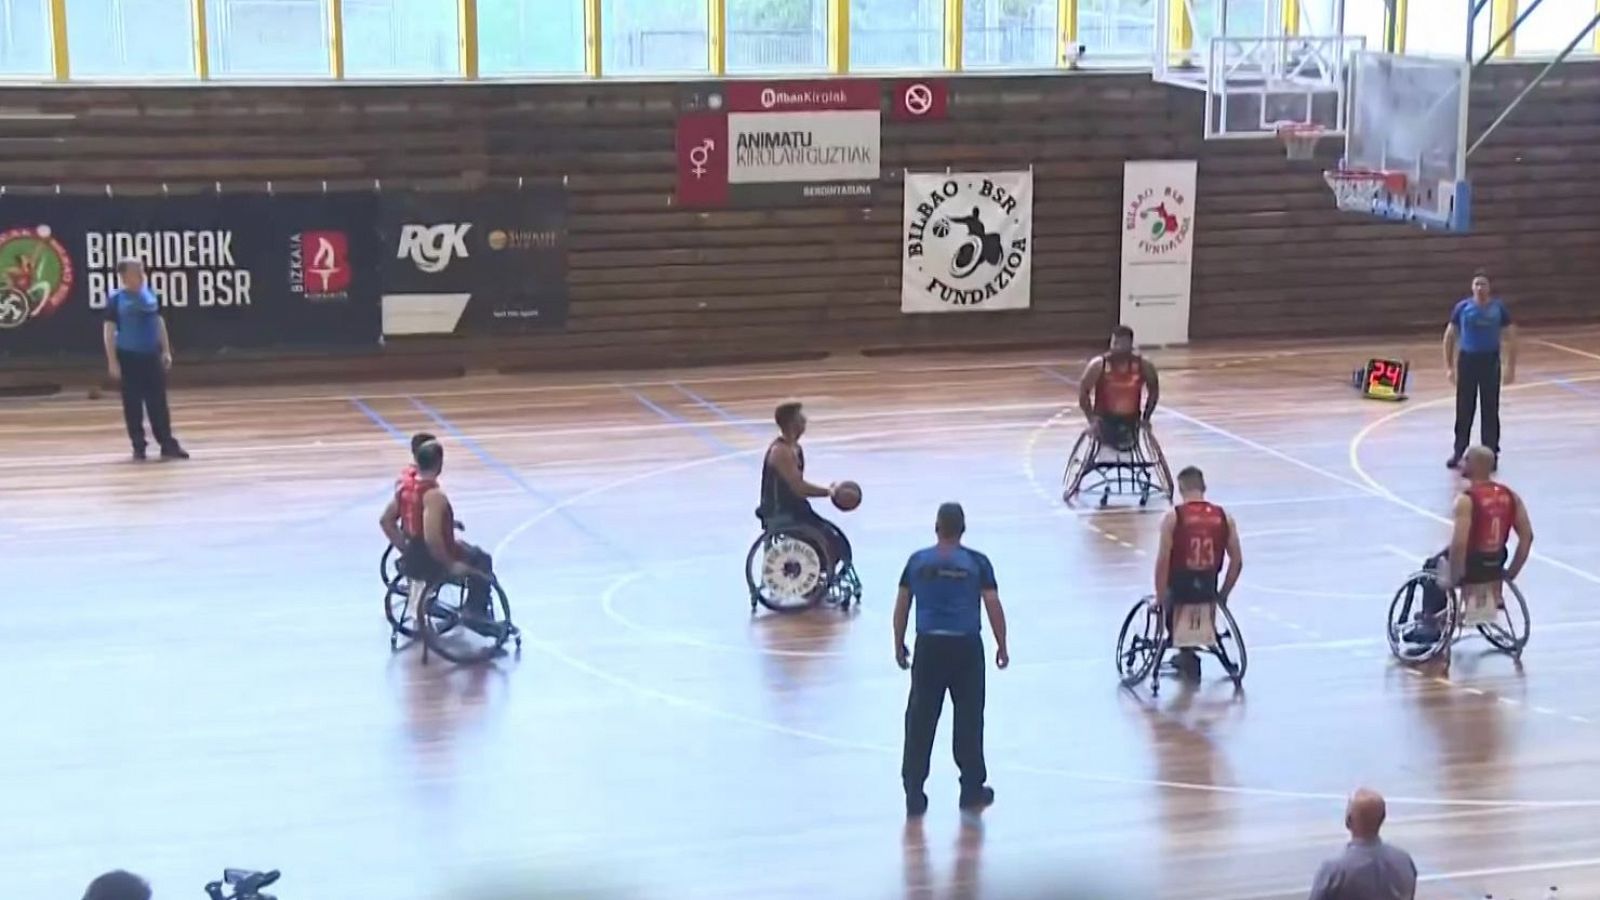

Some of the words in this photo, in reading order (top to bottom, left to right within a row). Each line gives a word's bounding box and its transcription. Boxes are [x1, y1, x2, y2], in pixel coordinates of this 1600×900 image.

[736, 131, 812, 149] ANIMATU
[806, 146, 871, 165] GUZTIAK
[908, 180, 959, 258] BILBAO
[979, 179, 1016, 215] BSR
[86, 231, 235, 268] BIDAIDEAK
[290, 232, 304, 293] BIZKAIA
[198, 270, 251, 306] BSR
[926, 238, 1026, 305] FUNDAZIOA
[1369, 362, 1400, 393] 24
[1186, 537, 1215, 570] 33
